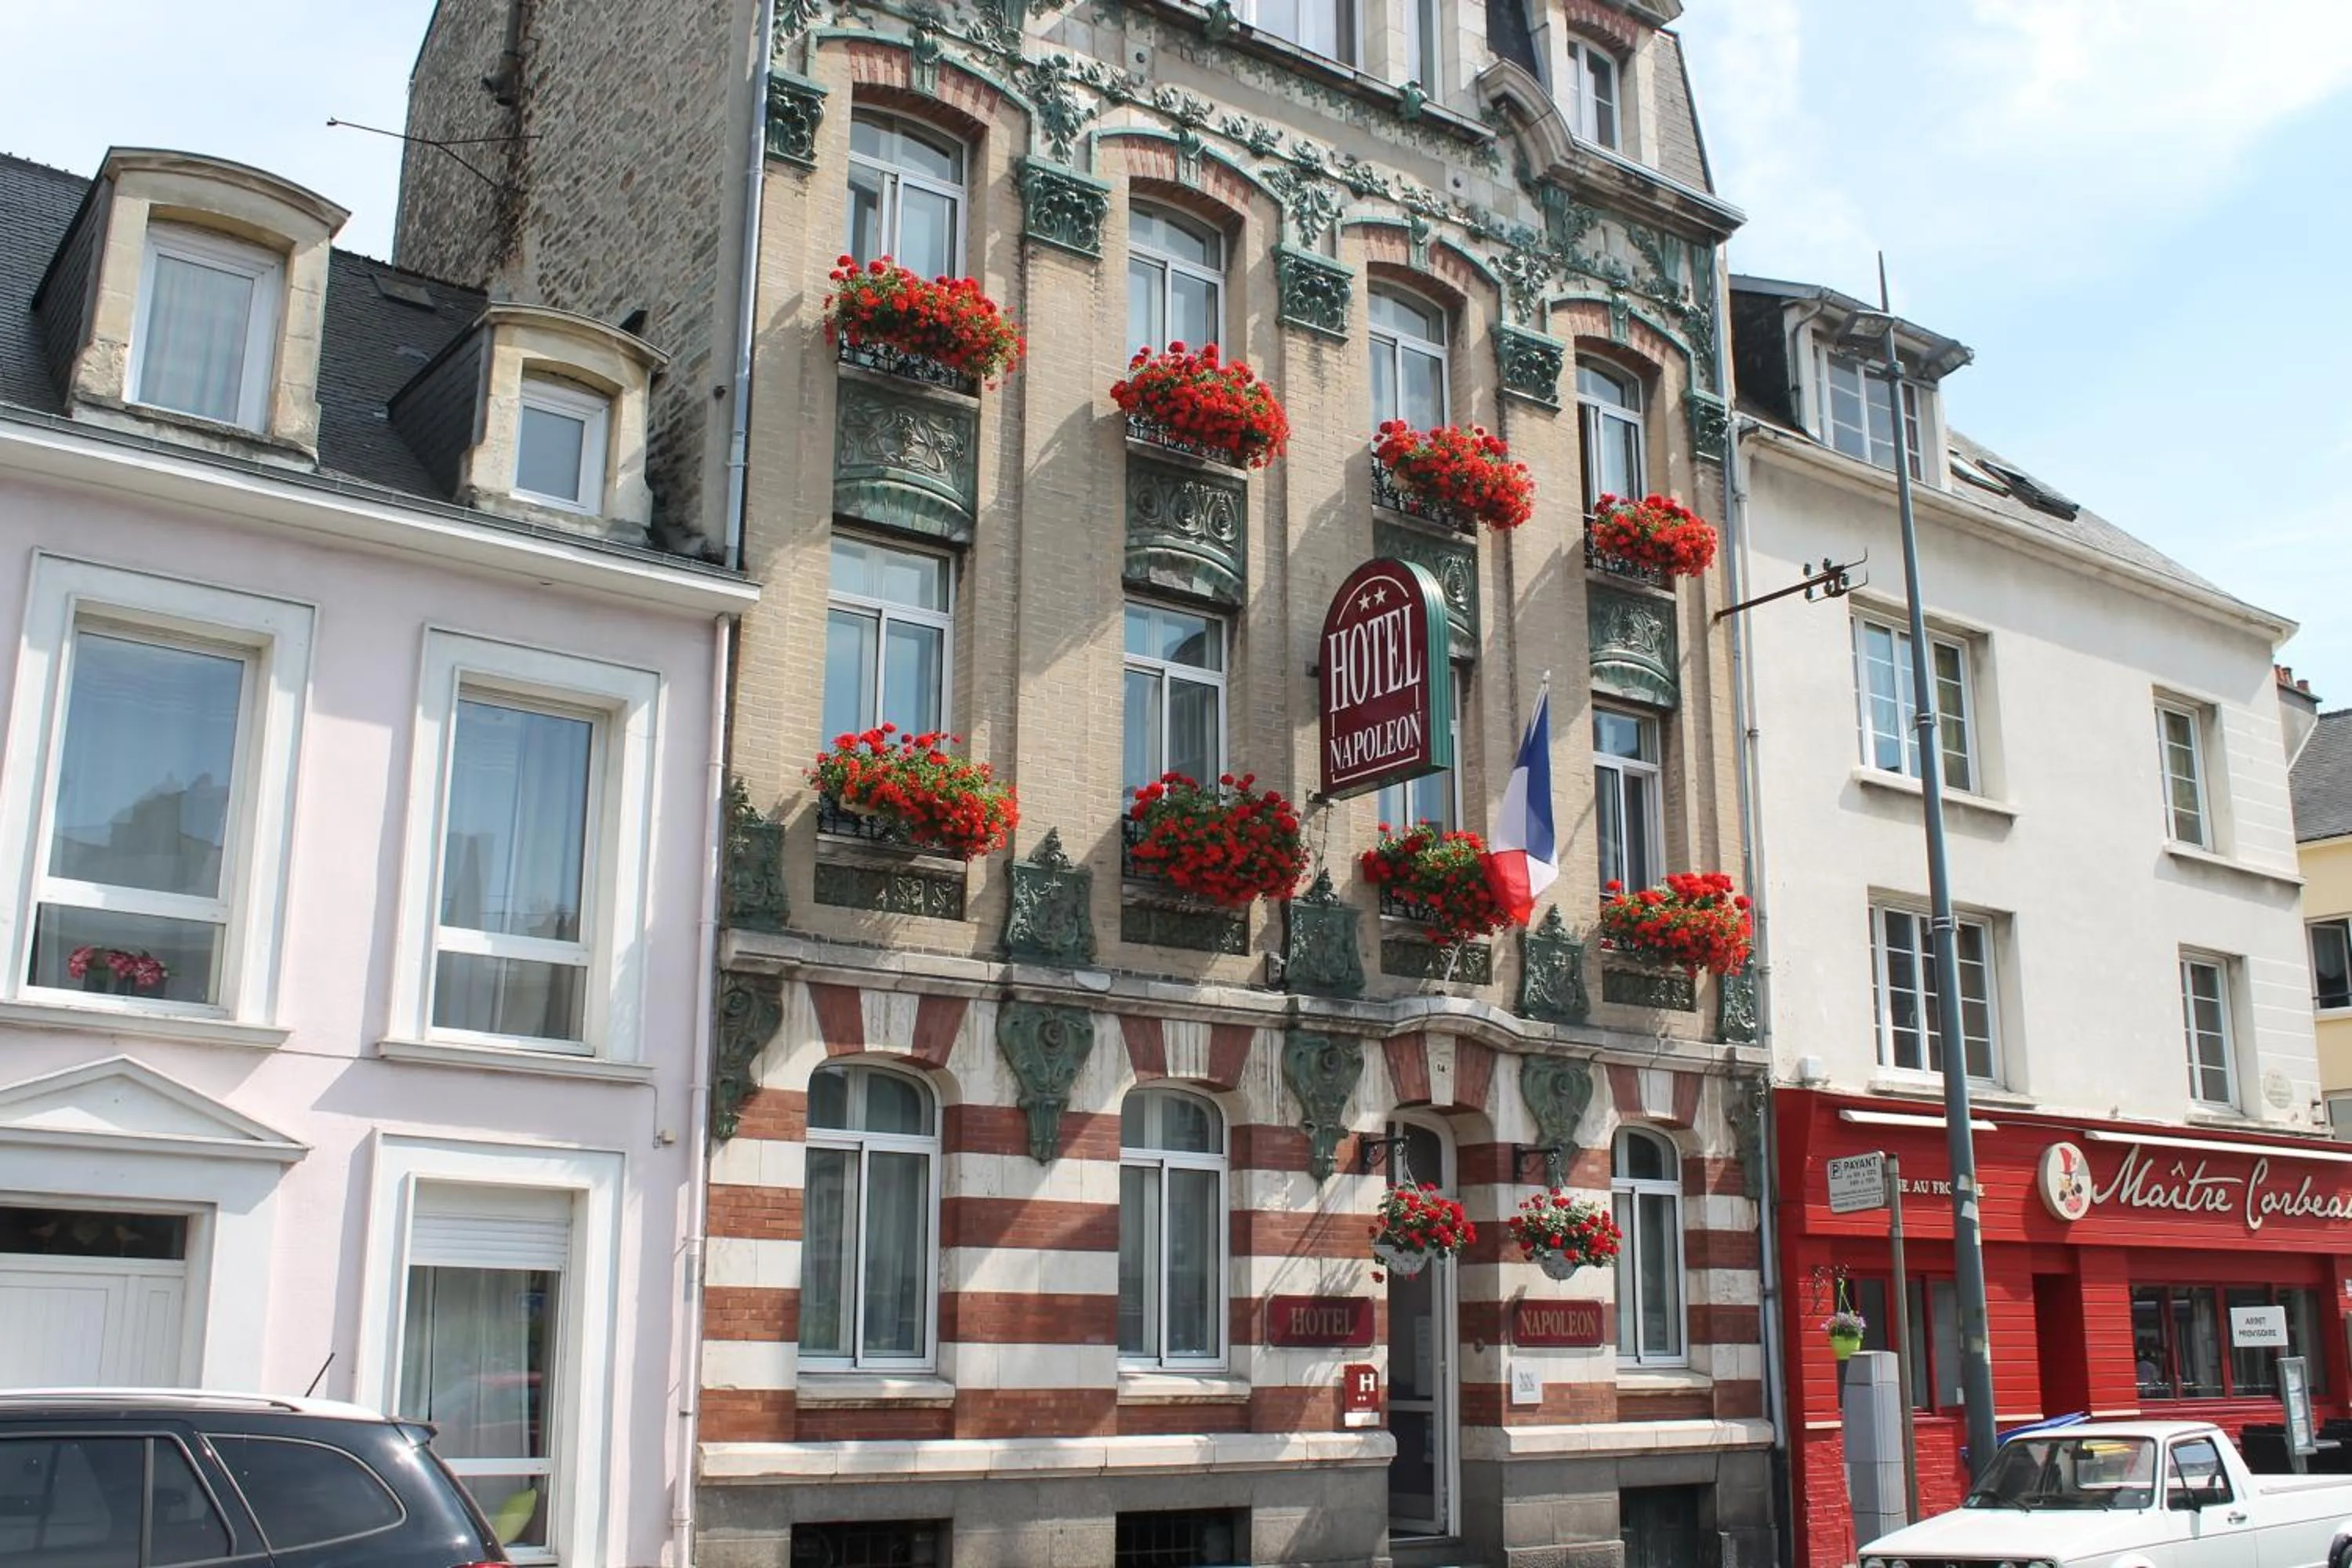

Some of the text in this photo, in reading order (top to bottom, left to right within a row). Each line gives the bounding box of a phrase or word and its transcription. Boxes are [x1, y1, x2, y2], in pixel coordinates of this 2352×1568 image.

[1328, 604, 1421, 713] HOTEL
[1330, 711, 1421, 772] NAPOLEON
[1844, 1156, 1877, 1171] PAYANT
[1912, 1180, 1929, 1193] AU
[2092, 1144, 2244, 1212] Maître
[1290, 1307, 1355, 1336] HOTEL
[1520, 1309, 1596, 1337] NAPOLEON
[1359, 1373, 1375, 1392] H
